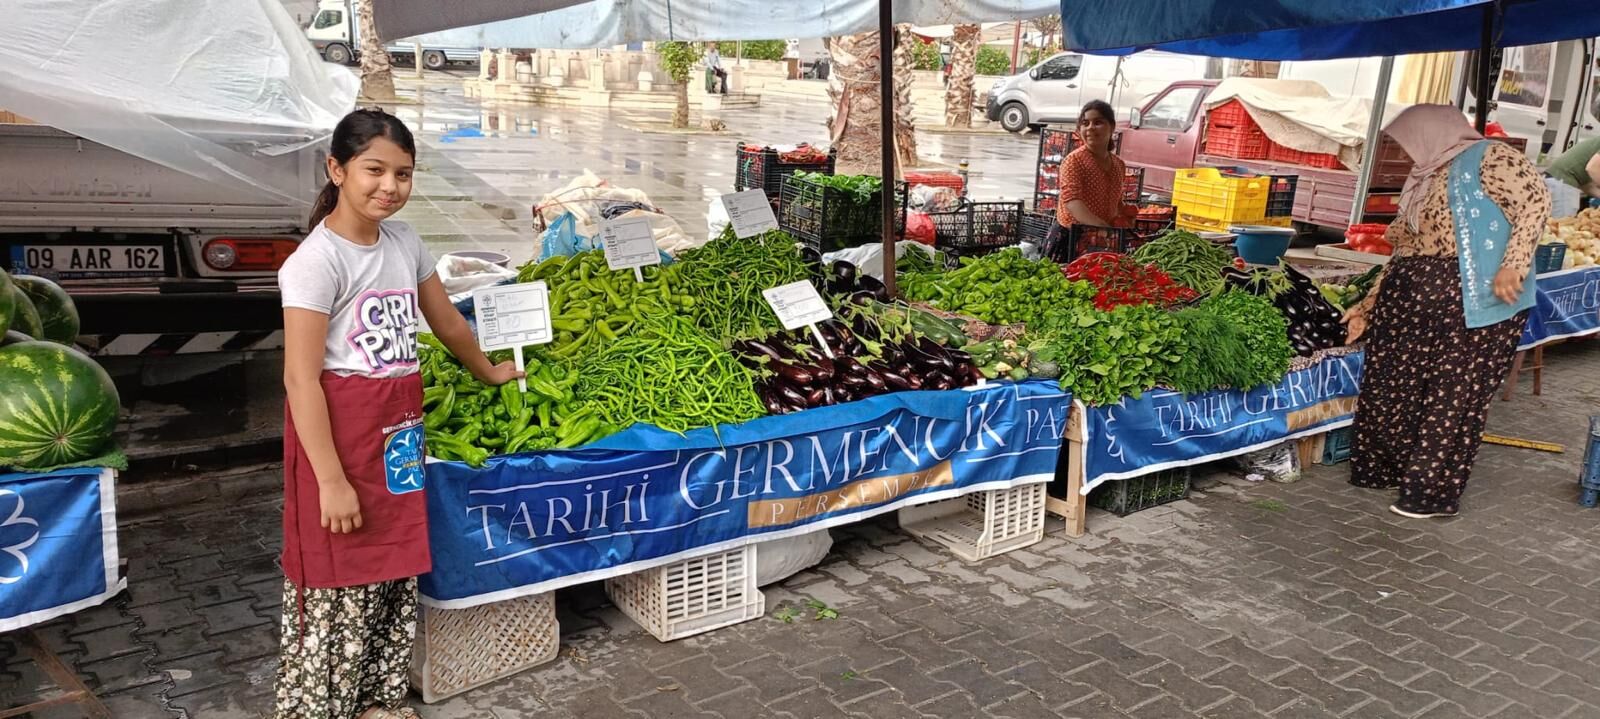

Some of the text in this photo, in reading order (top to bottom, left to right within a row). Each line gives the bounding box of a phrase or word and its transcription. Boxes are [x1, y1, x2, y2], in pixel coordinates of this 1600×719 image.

[26, 248, 160, 269] 09 AAR 162
[361, 293, 417, 330] GIRL
[466, 473, 649, 550] TARİHİ
